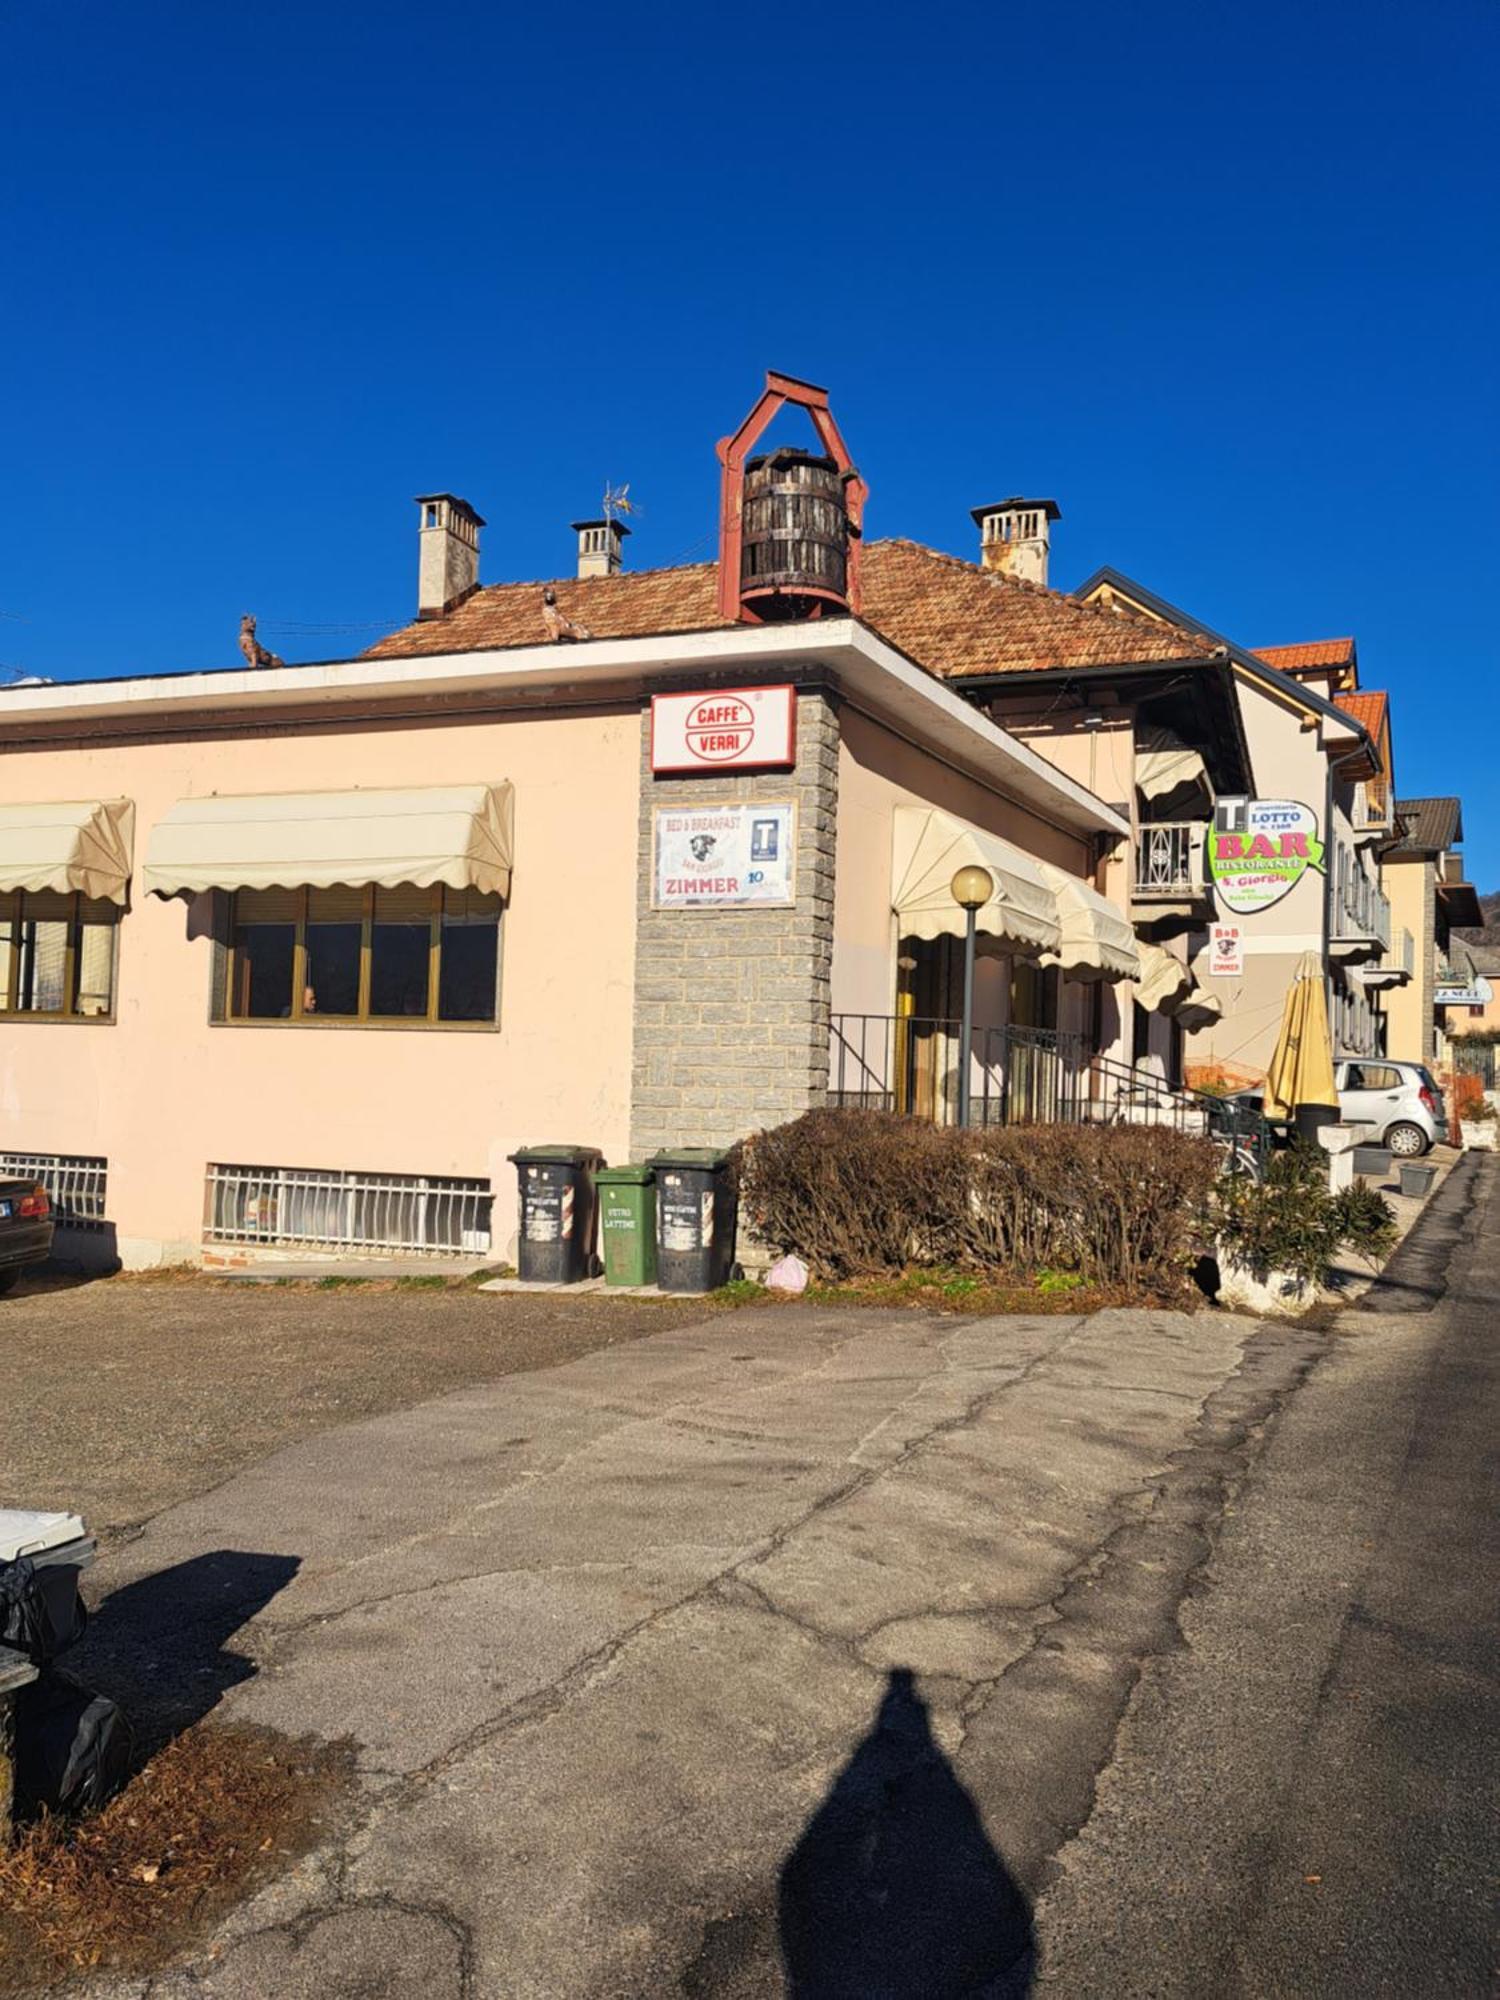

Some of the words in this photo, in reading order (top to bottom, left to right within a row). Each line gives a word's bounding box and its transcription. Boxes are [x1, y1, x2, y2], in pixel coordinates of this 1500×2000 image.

[699, 734, 740, 751] VERRI
[1218, 799, 1245, 830] T
[1251, 811, 1301, 824] LOTTO
[666, 819, 682, 832] BED
[691, 816, 741, 832] BREAKFAST
[1215, 832, 1311, 861] BAR
[1216, 859, 1300, 871] RISTORANTE
[665, 877, 739, 894] ZIMMER
[1237, 873, 1288, 887] Giorgio
